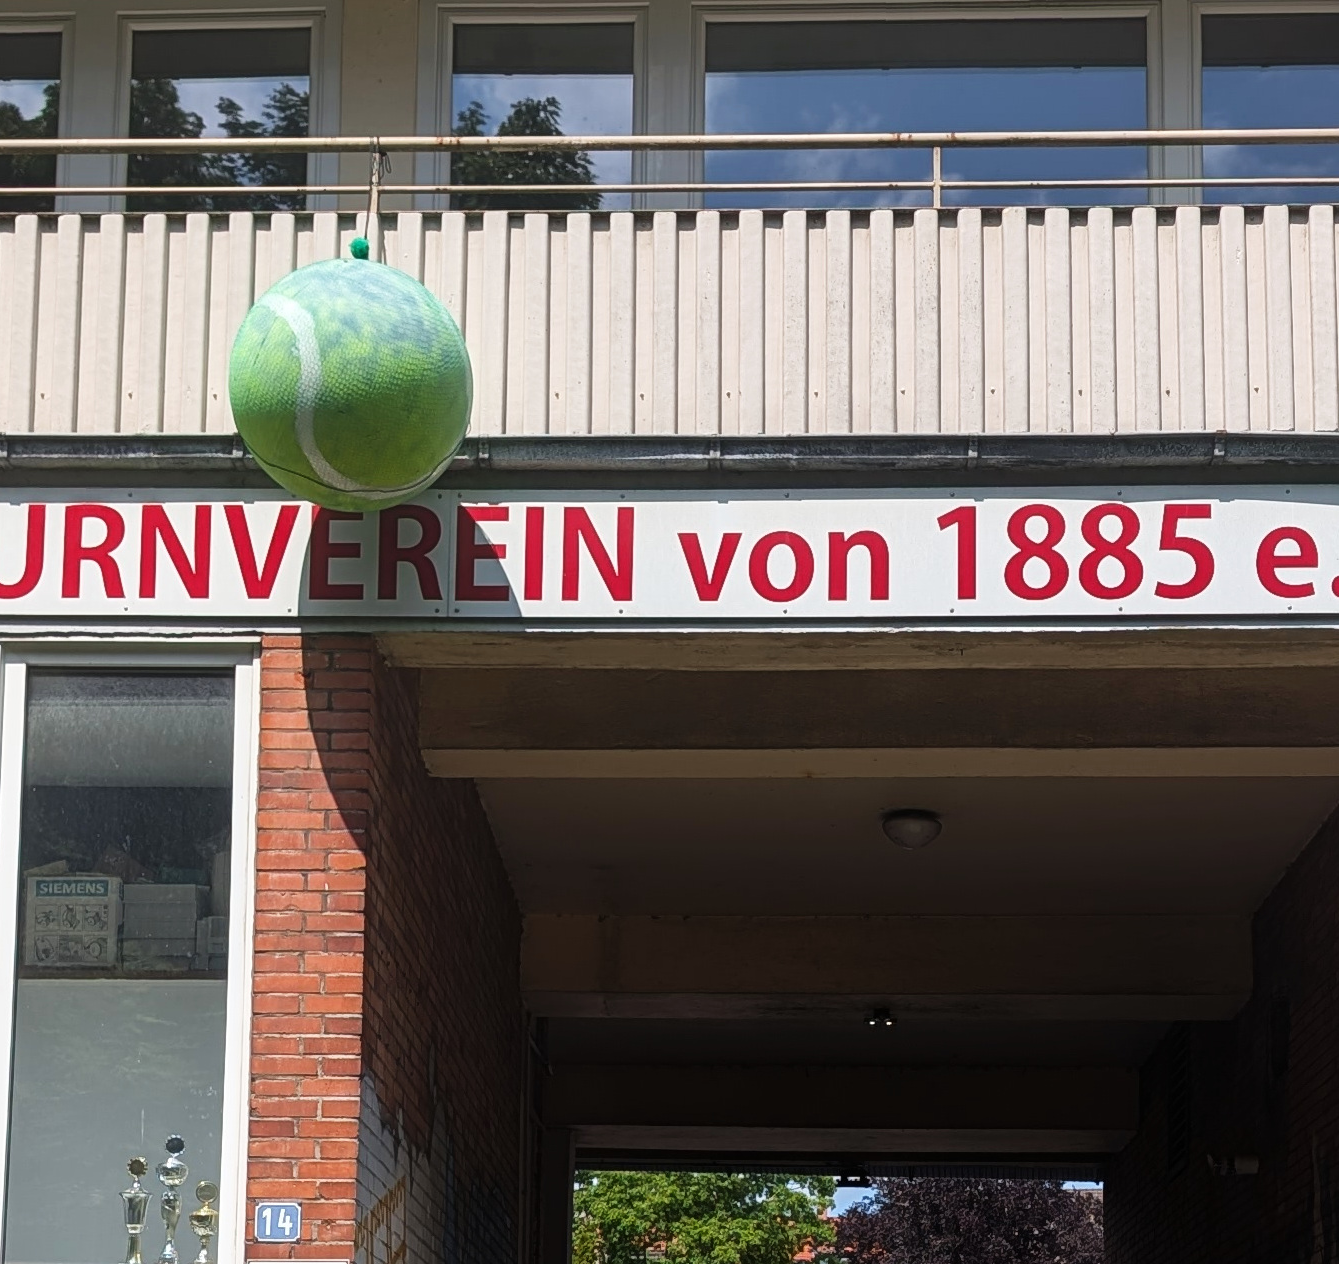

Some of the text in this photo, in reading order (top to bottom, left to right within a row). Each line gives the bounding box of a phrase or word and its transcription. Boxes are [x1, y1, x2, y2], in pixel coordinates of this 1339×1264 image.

[677, 530, 889, 602] von
[937, 503, 1214, 600] 1885
[39, 883, 105, 894] SIEMENS
[262, 1207, 293, 1236] 14
